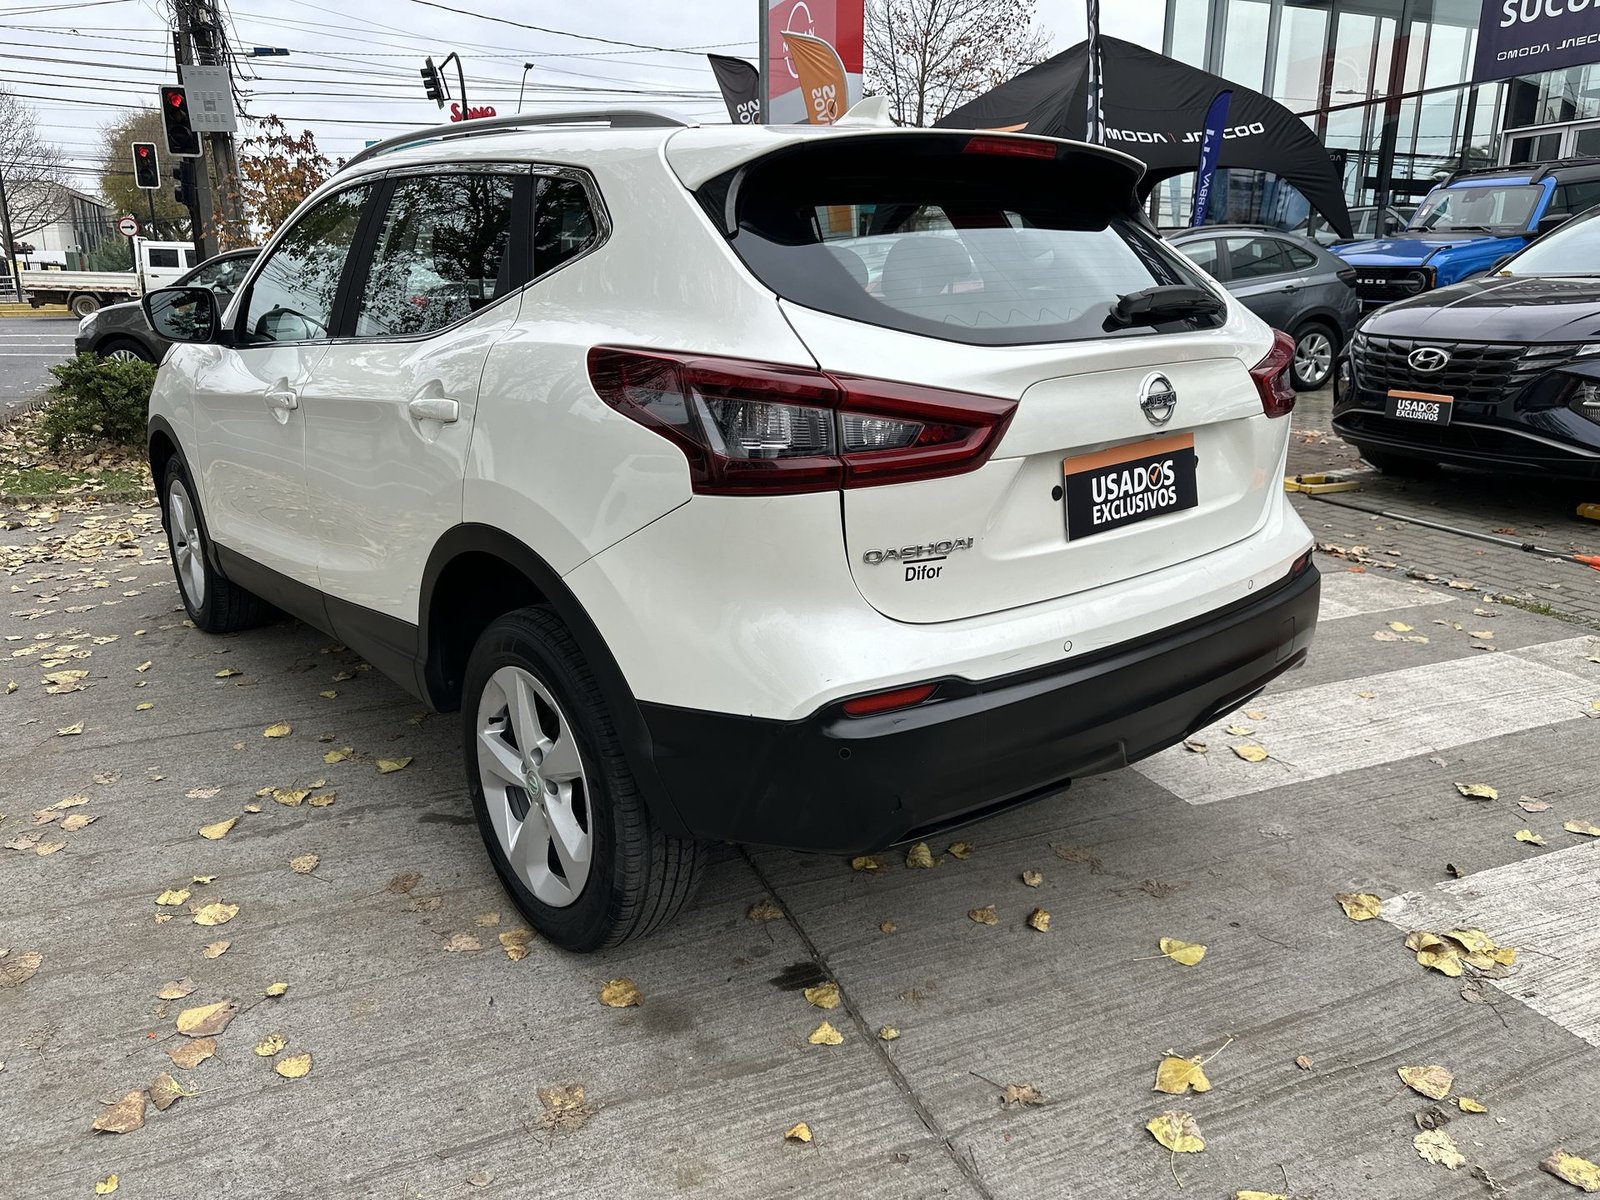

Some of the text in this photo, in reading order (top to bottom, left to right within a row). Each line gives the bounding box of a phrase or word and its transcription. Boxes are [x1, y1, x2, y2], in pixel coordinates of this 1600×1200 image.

[1500, 0, 1600, 28] SUC
[1497, 33, 1600, 61] OMODA JAEC
[1104, 122, 1265, 144] MODA JACOO
[1199, 173, 1211, 205] BBVA
[1396, 409, 1438, 421] EXCLUSIVOS
[1397, 399, 1440, 414] USADOS
[1091, 459, 1175, 503] USADOS
[1092, 486, 1177, 525] EXCLUSIVOS
[863, 536, 974, 565] QASHQAI
[904, 565, 942, 581] Difor
